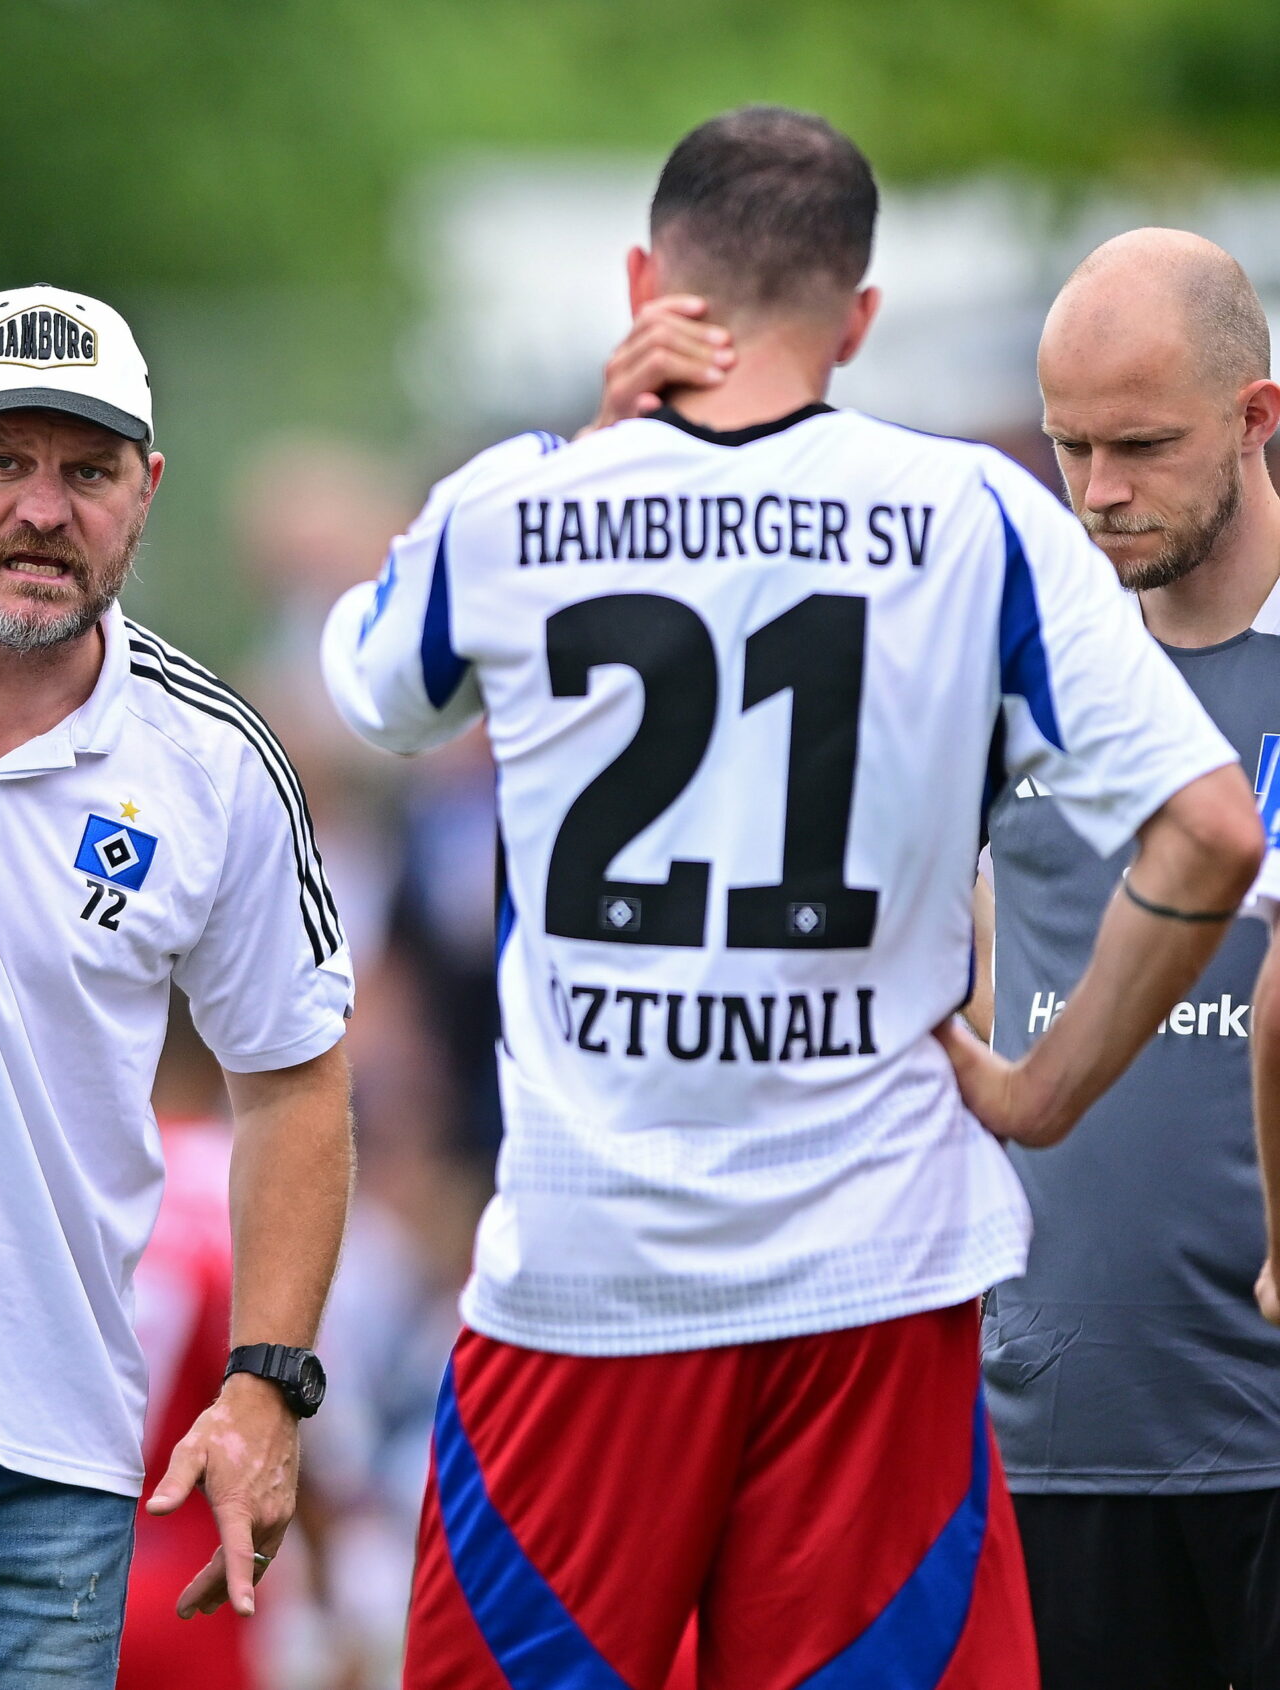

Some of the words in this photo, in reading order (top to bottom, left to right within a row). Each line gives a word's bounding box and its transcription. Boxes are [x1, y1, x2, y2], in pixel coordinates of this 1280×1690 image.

[517, 495, 850, 567] HAMBURGER
[868, 505, 933, 566] SV
[544, 593, 880, 948] 21
[80, 879, 127, 931] 72
